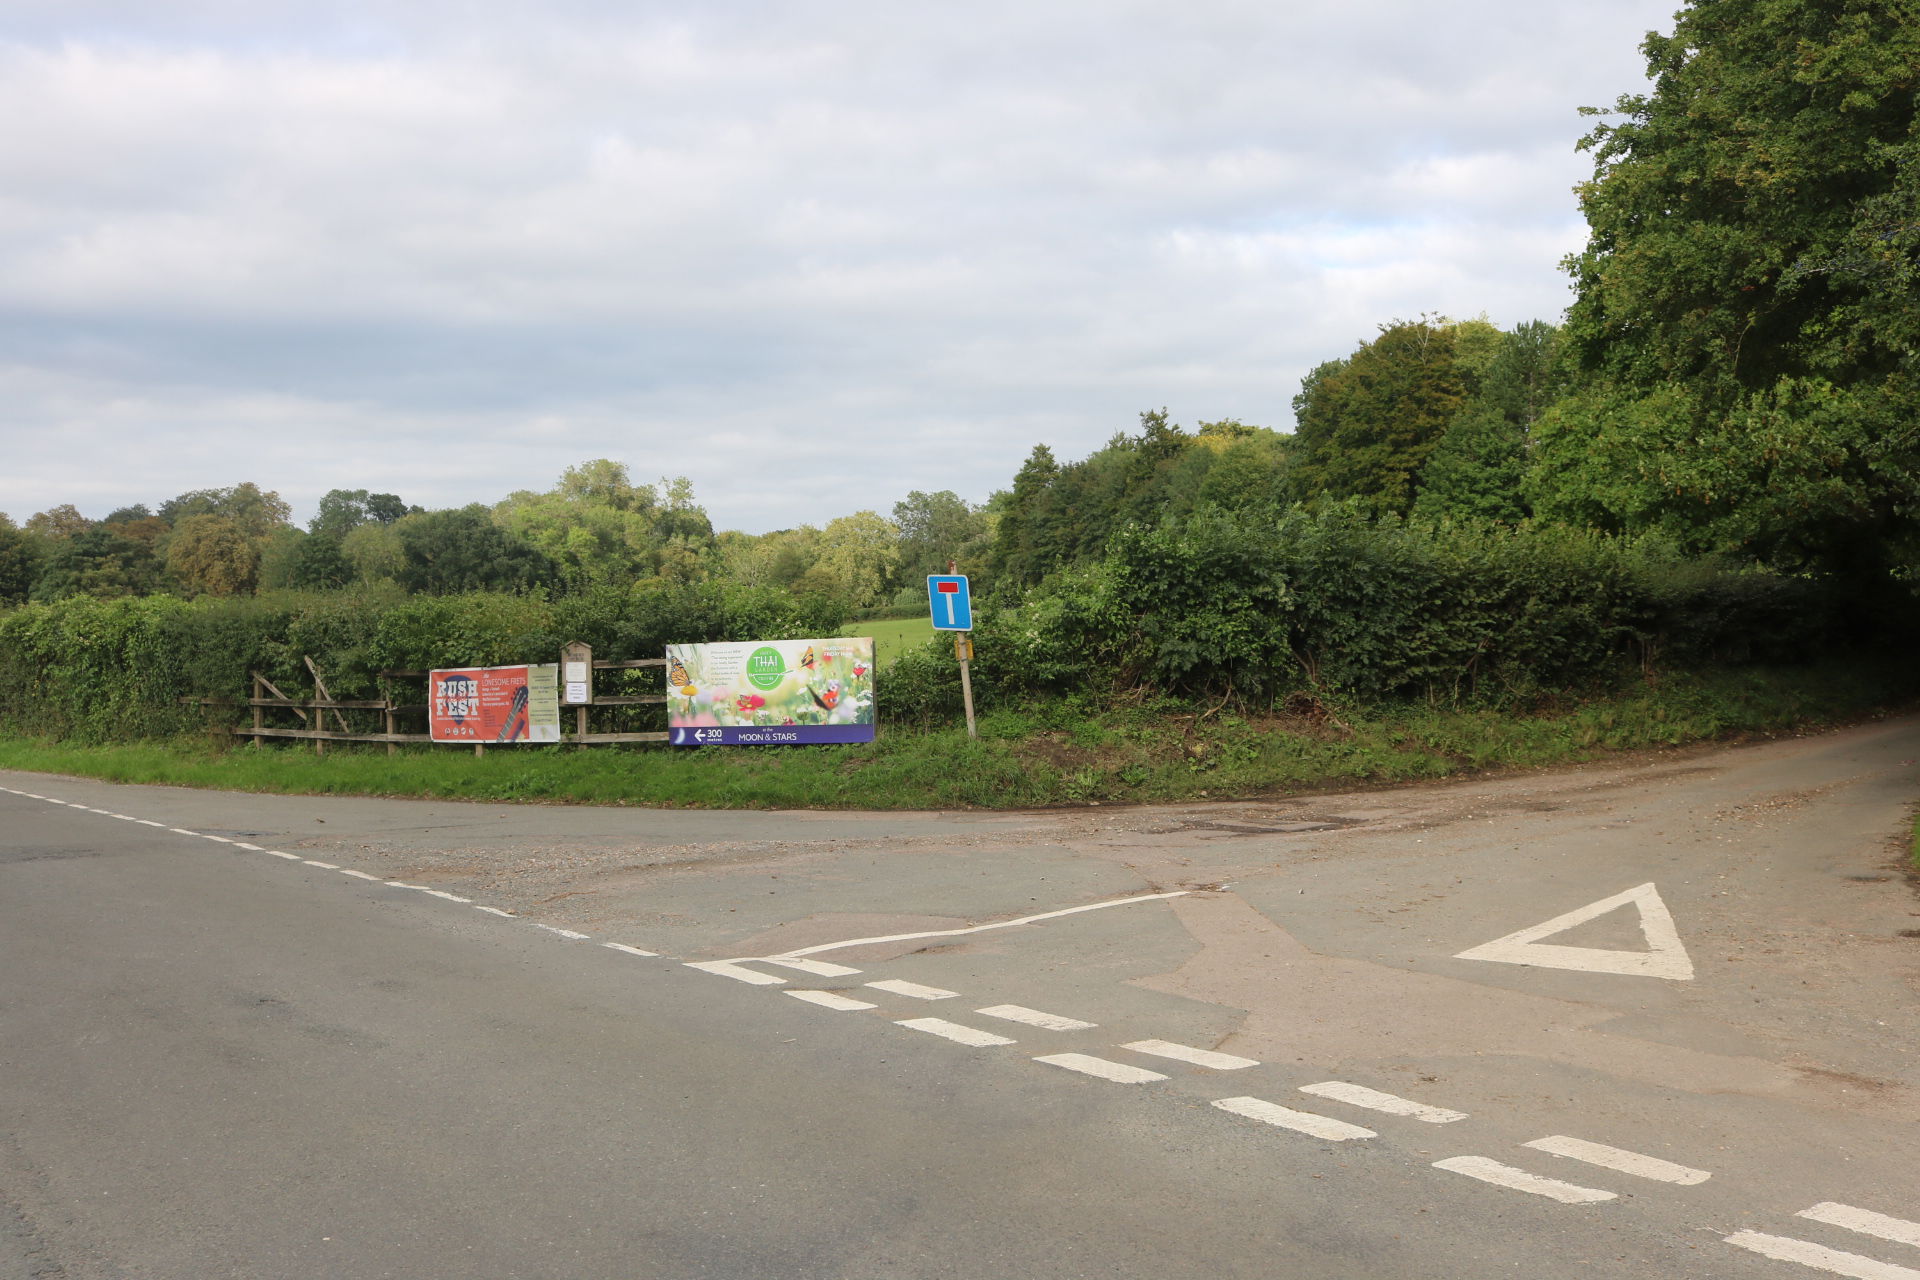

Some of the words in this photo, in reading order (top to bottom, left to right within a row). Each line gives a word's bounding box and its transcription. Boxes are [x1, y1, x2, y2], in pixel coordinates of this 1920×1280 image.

[753, 655, 778, 667] THAI
[482, 678, 510, 687] LONESOME
[436, 680, 479, 698] RUSH
[436, 697, 480, 716] FEST
[707, 729, 722, 738] 300
[738, 733, 763, 741] MOON
[764, 733, 771, 741] &
[772, 732, 797, 741] STARS
